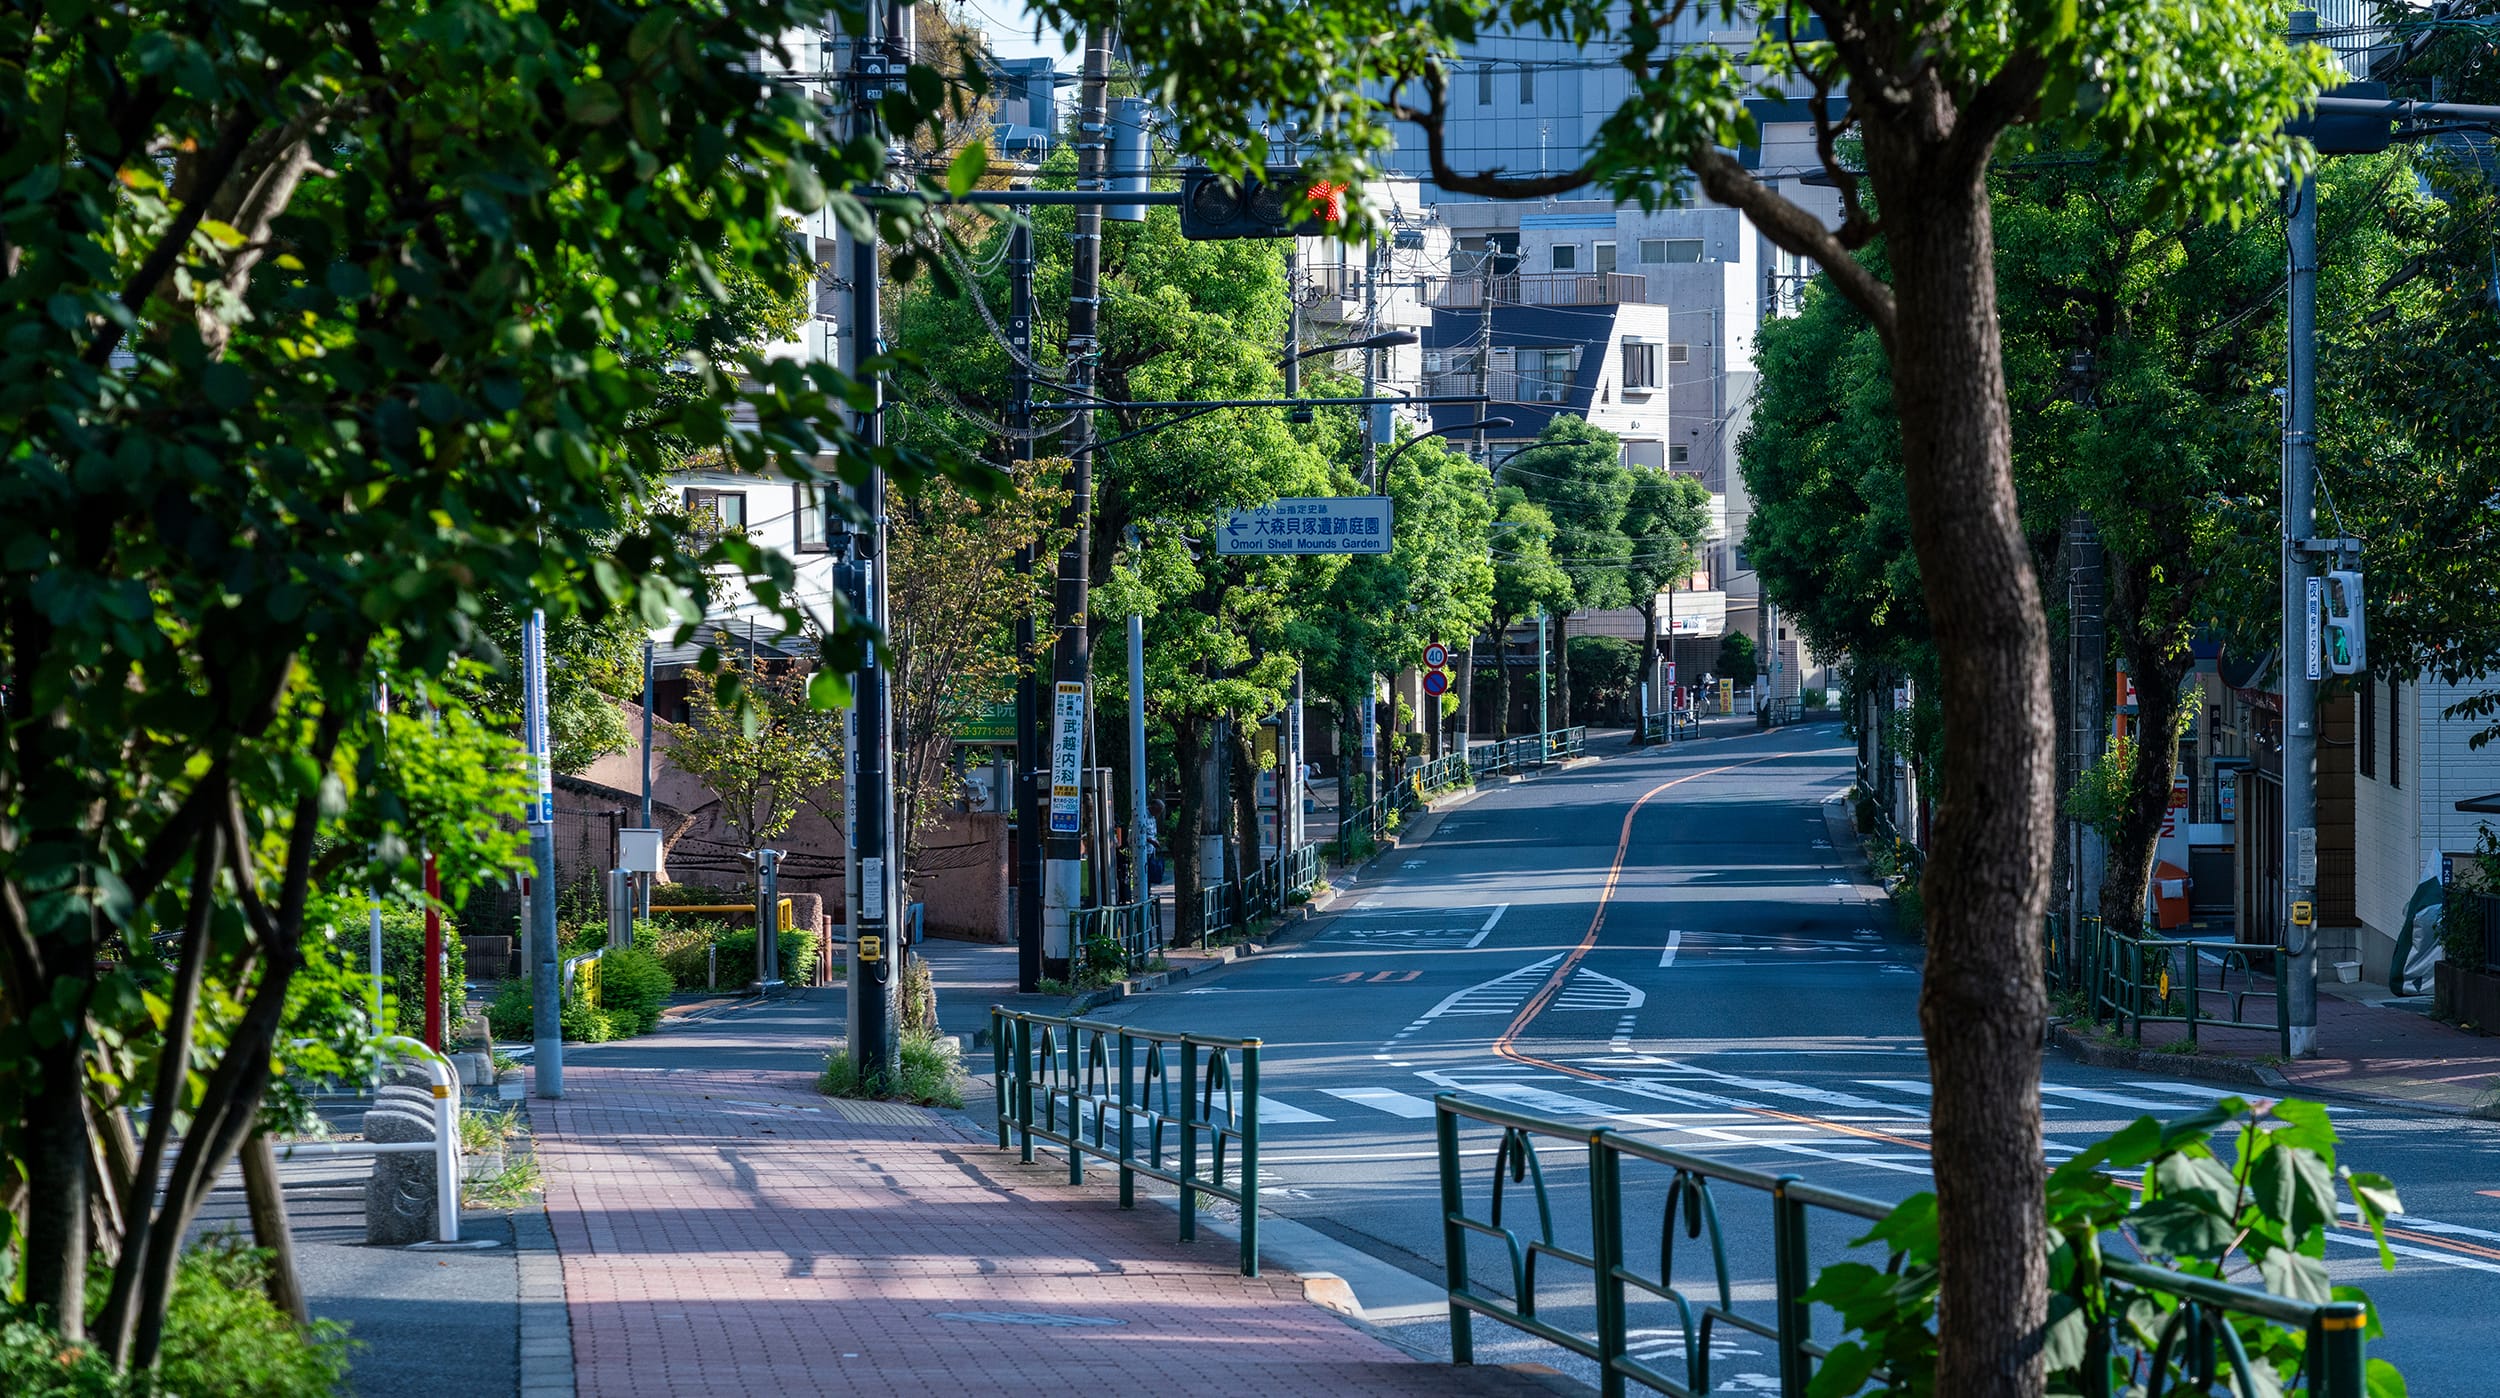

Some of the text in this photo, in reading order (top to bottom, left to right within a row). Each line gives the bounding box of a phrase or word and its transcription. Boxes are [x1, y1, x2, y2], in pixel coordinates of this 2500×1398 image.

[1254, 517, 1379, 536] 大森貝塚遺跡庭園
[1231, 537, 1380, 550] Omori Shell Mounds Garden
[1428, 650, 1443, 662] 40
[1061, 719, 1077, 785] 武越内科
[1054, 743, 1062, 784] クリニック
[1309, 970, 1424, 984] 40
